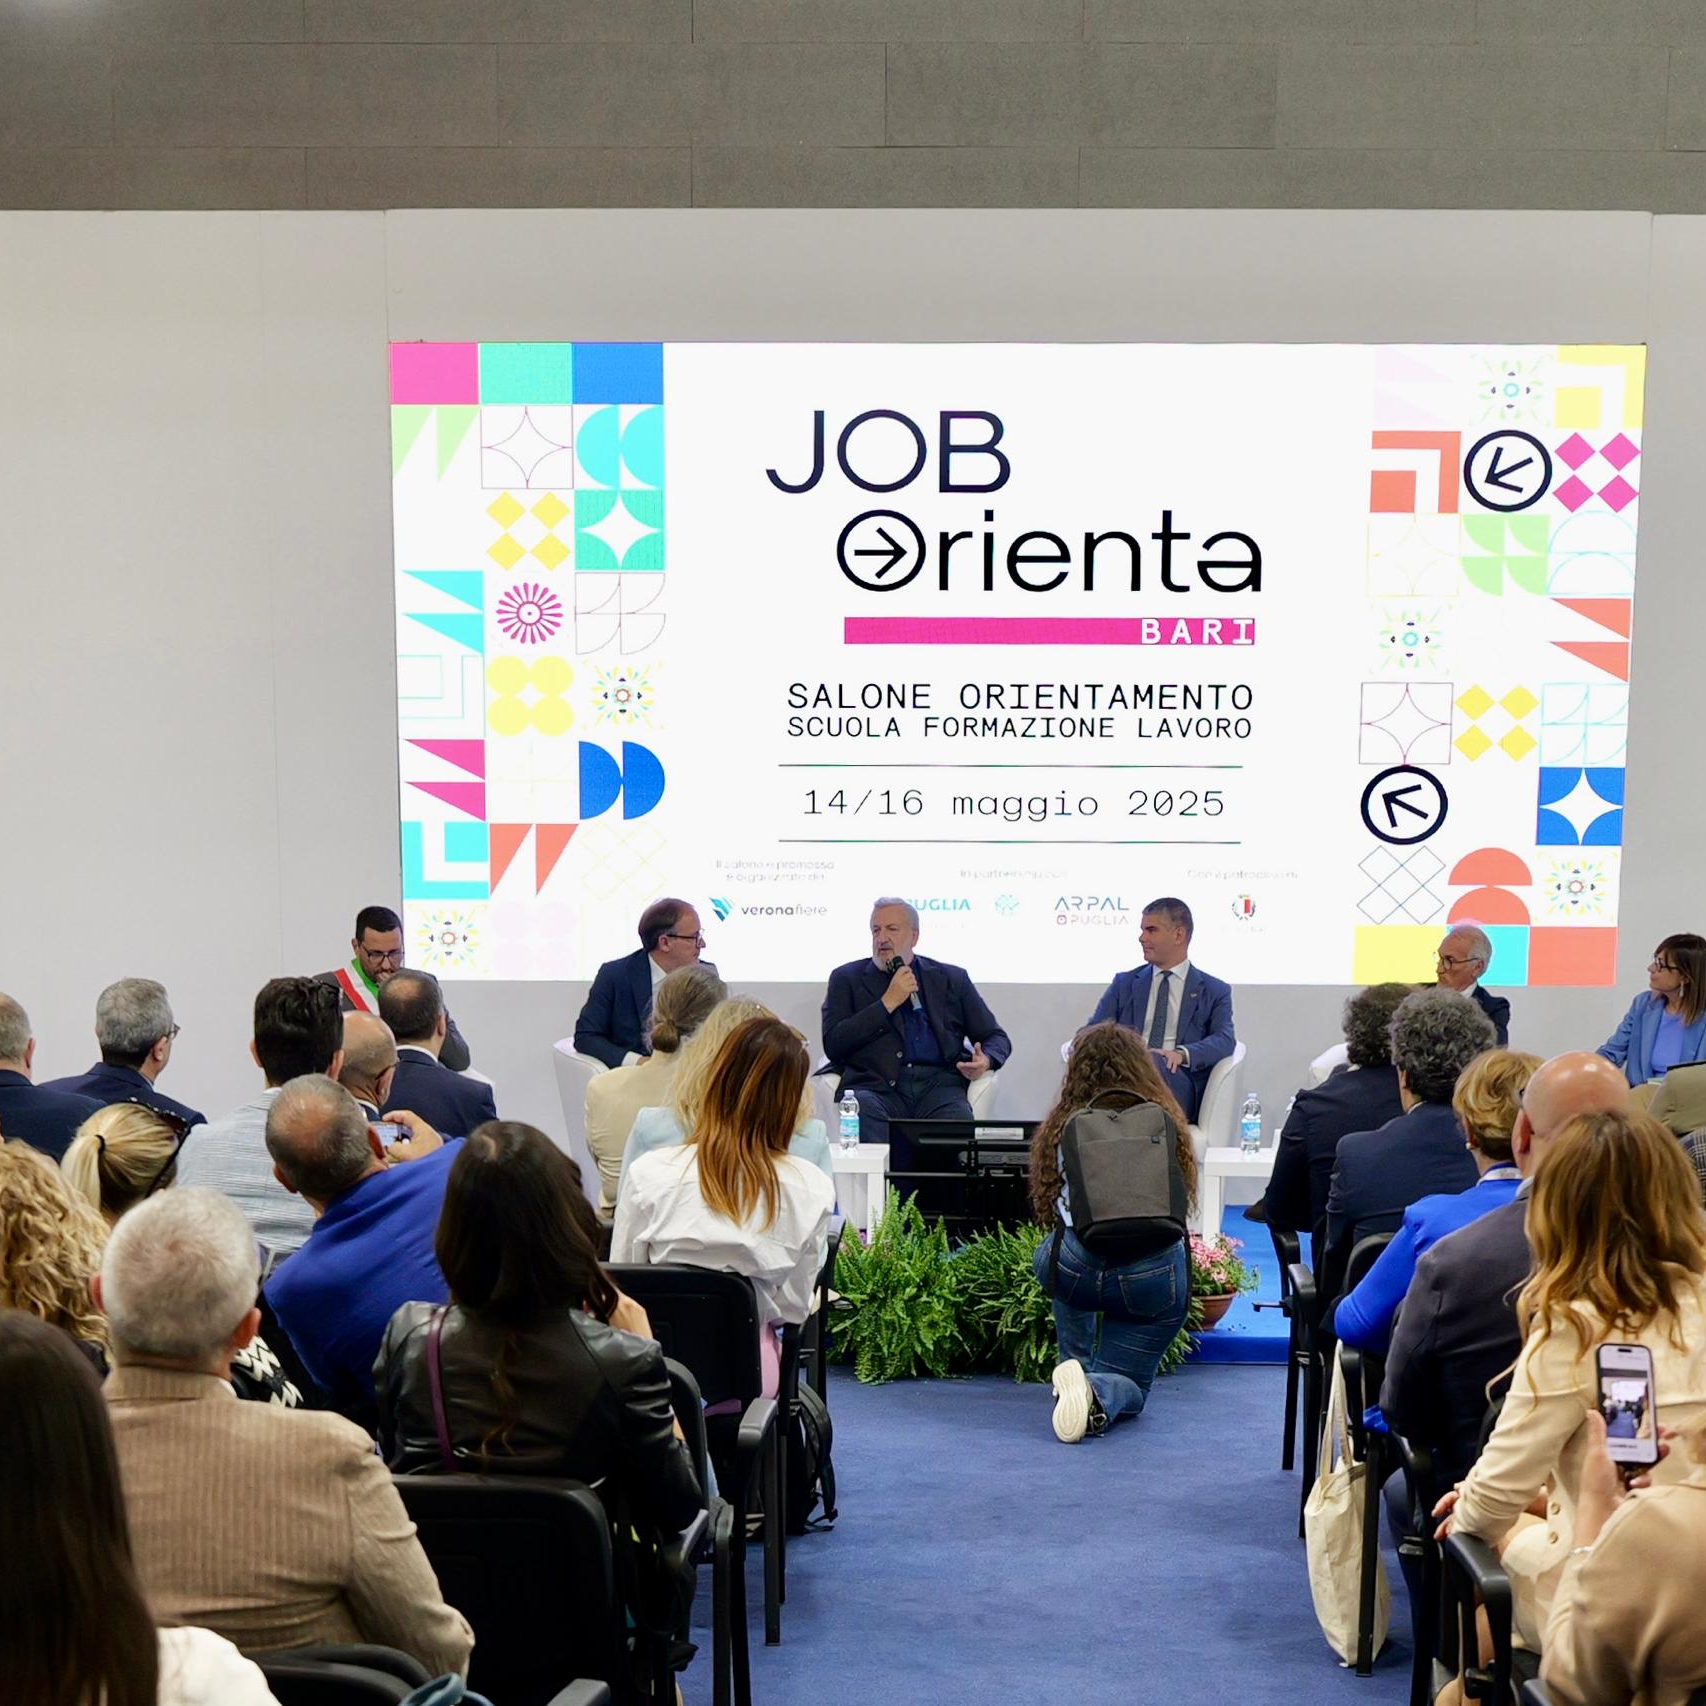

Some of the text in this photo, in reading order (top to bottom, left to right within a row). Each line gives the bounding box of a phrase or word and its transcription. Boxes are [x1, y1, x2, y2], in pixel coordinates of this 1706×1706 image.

[765, 409, 1011, 494] JOB
[836, 509, 1262, 593] Orienta
[1141, 618, 1256, 646] BARI
[787, 682, 1253, 711] SALONE ORIENTAMENTO
[787, 716, 1252, 739] SCUOLA FORMAZIONE LAVORO
[803, 788, 1225, 823] 14/16 maggio 2025
[740, 903, 829, 916] veronafiere
[1054, 895, 1130, 912] ARPAL
[1069, 913, 1129, 927] PUGLIA
